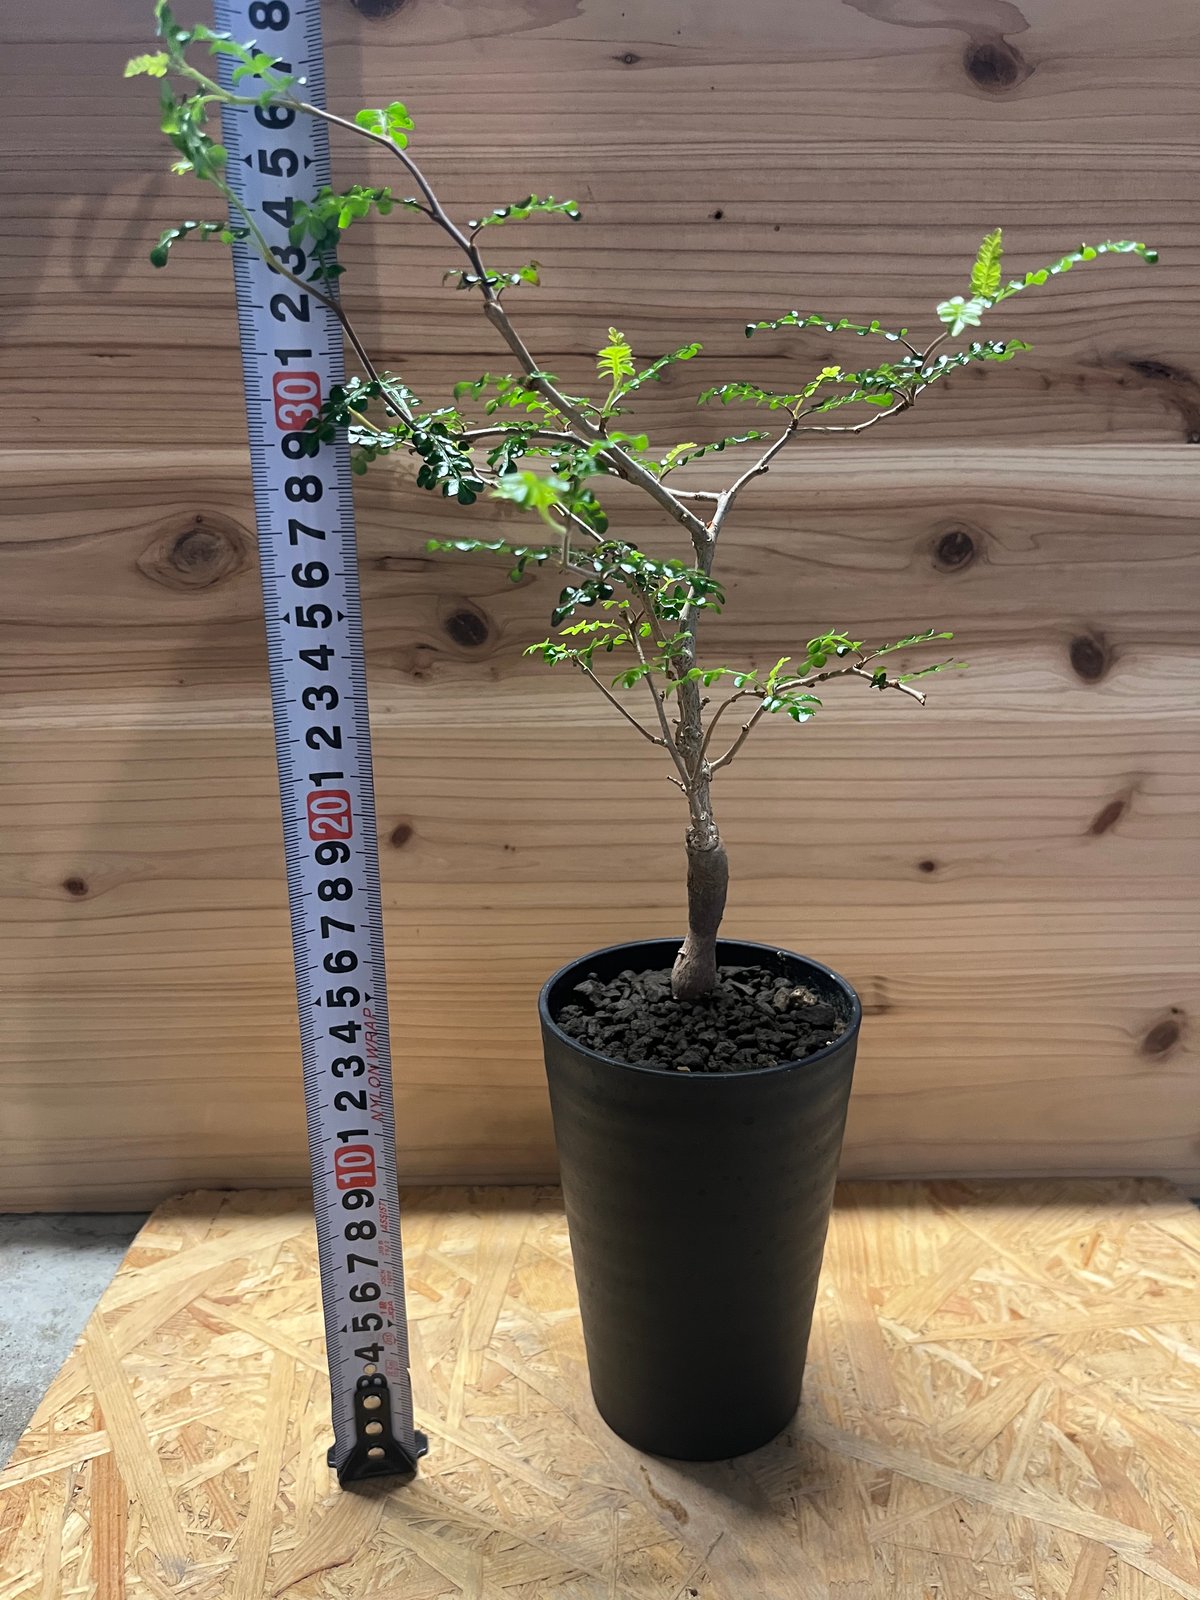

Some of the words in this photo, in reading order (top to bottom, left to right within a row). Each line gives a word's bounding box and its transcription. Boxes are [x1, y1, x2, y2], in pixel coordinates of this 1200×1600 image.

[254, 102, 296, 129] 6
[258, 148, 299, 178] 5
[262, 196, 299, 229] 4
[266, 245, 306, 275] 3
[270, 293, 310, 323] 2
[274, 349, 312, 366] 1
[276, 377, 319, 426] 30
[281, 431, 320, 460] 9
[284, 475, 323, 503] 8
[288, 518, 326, 546] 7
[291, 561, 330, 588] 6
[295, 603, 333, 629] 5
[298, 644, 335, 671] 4
[302, 684, 339, 711] 3
[305, 726, 342, 750] 2
[309, 771, 344, 787] 1
[310, 796, 349, 834] 20
[315, 841, 350, 866] 9
[317, 877, 353, 902] 8
[320, 915, 355, 939] 7
[323, 950, 358, 974] 6
[326, 986, 361, 1008] 5
[329, 1020, 362, 1043] 4
[362, 1007, 380, 1061] WRAP
[331, 1055, 365, 1078] 3
[333, 1089, 368, 1112] 2
[366, 1062, 384, 1123] NYLON
[337, 1129, 369, 1143] 1
[337, 1151, 373, 1184] 10
[342, 1188, 375, 1211] 9
[344, 1219, 377, 1241] 8
[346, 1253, 379, 1274] 7
[349, 1281, 381, 1303] 6
[352, 1313, 384, 1332] 5
[354, 1342, 385, 1362] 4
